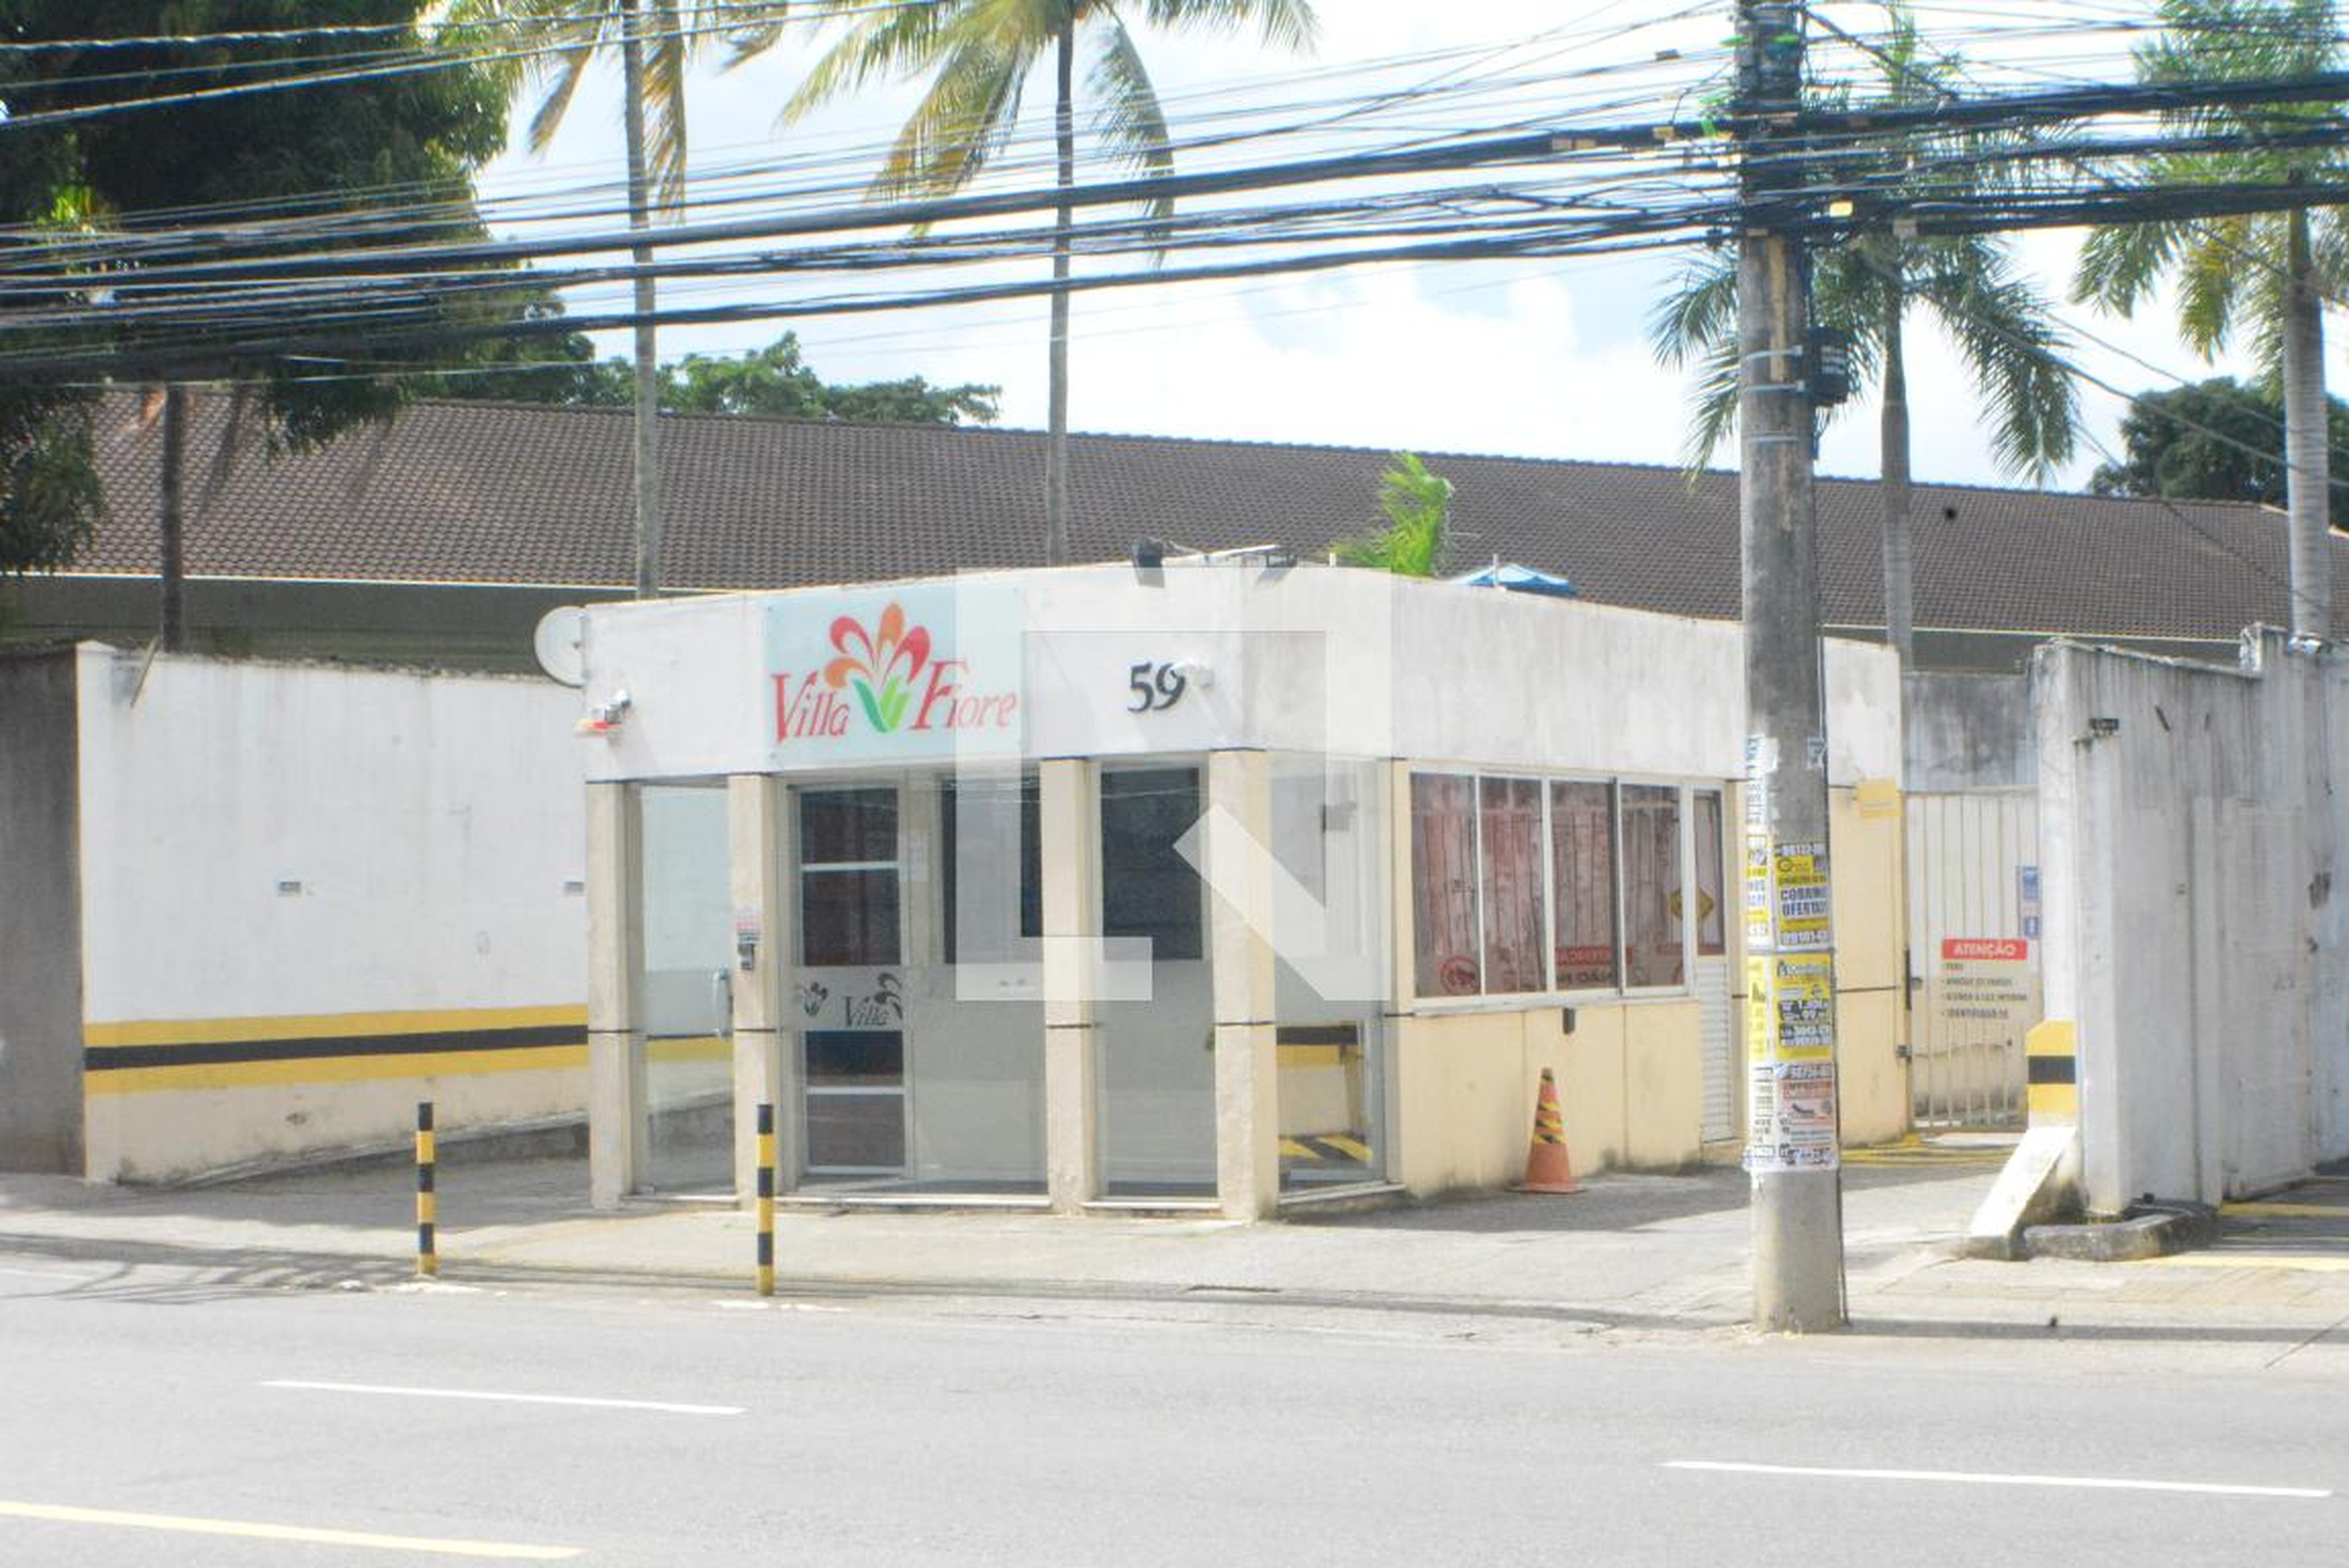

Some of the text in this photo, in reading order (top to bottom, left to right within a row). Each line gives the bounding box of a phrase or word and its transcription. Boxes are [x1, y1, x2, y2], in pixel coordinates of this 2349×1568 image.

[770, 659, 1017, 745] Villa Fiore
[1127, 662, 1186, 713] 59
[1954, 942, 2017, 958] ATENÇÃO
[839, 996, 889, 1028] Villa
